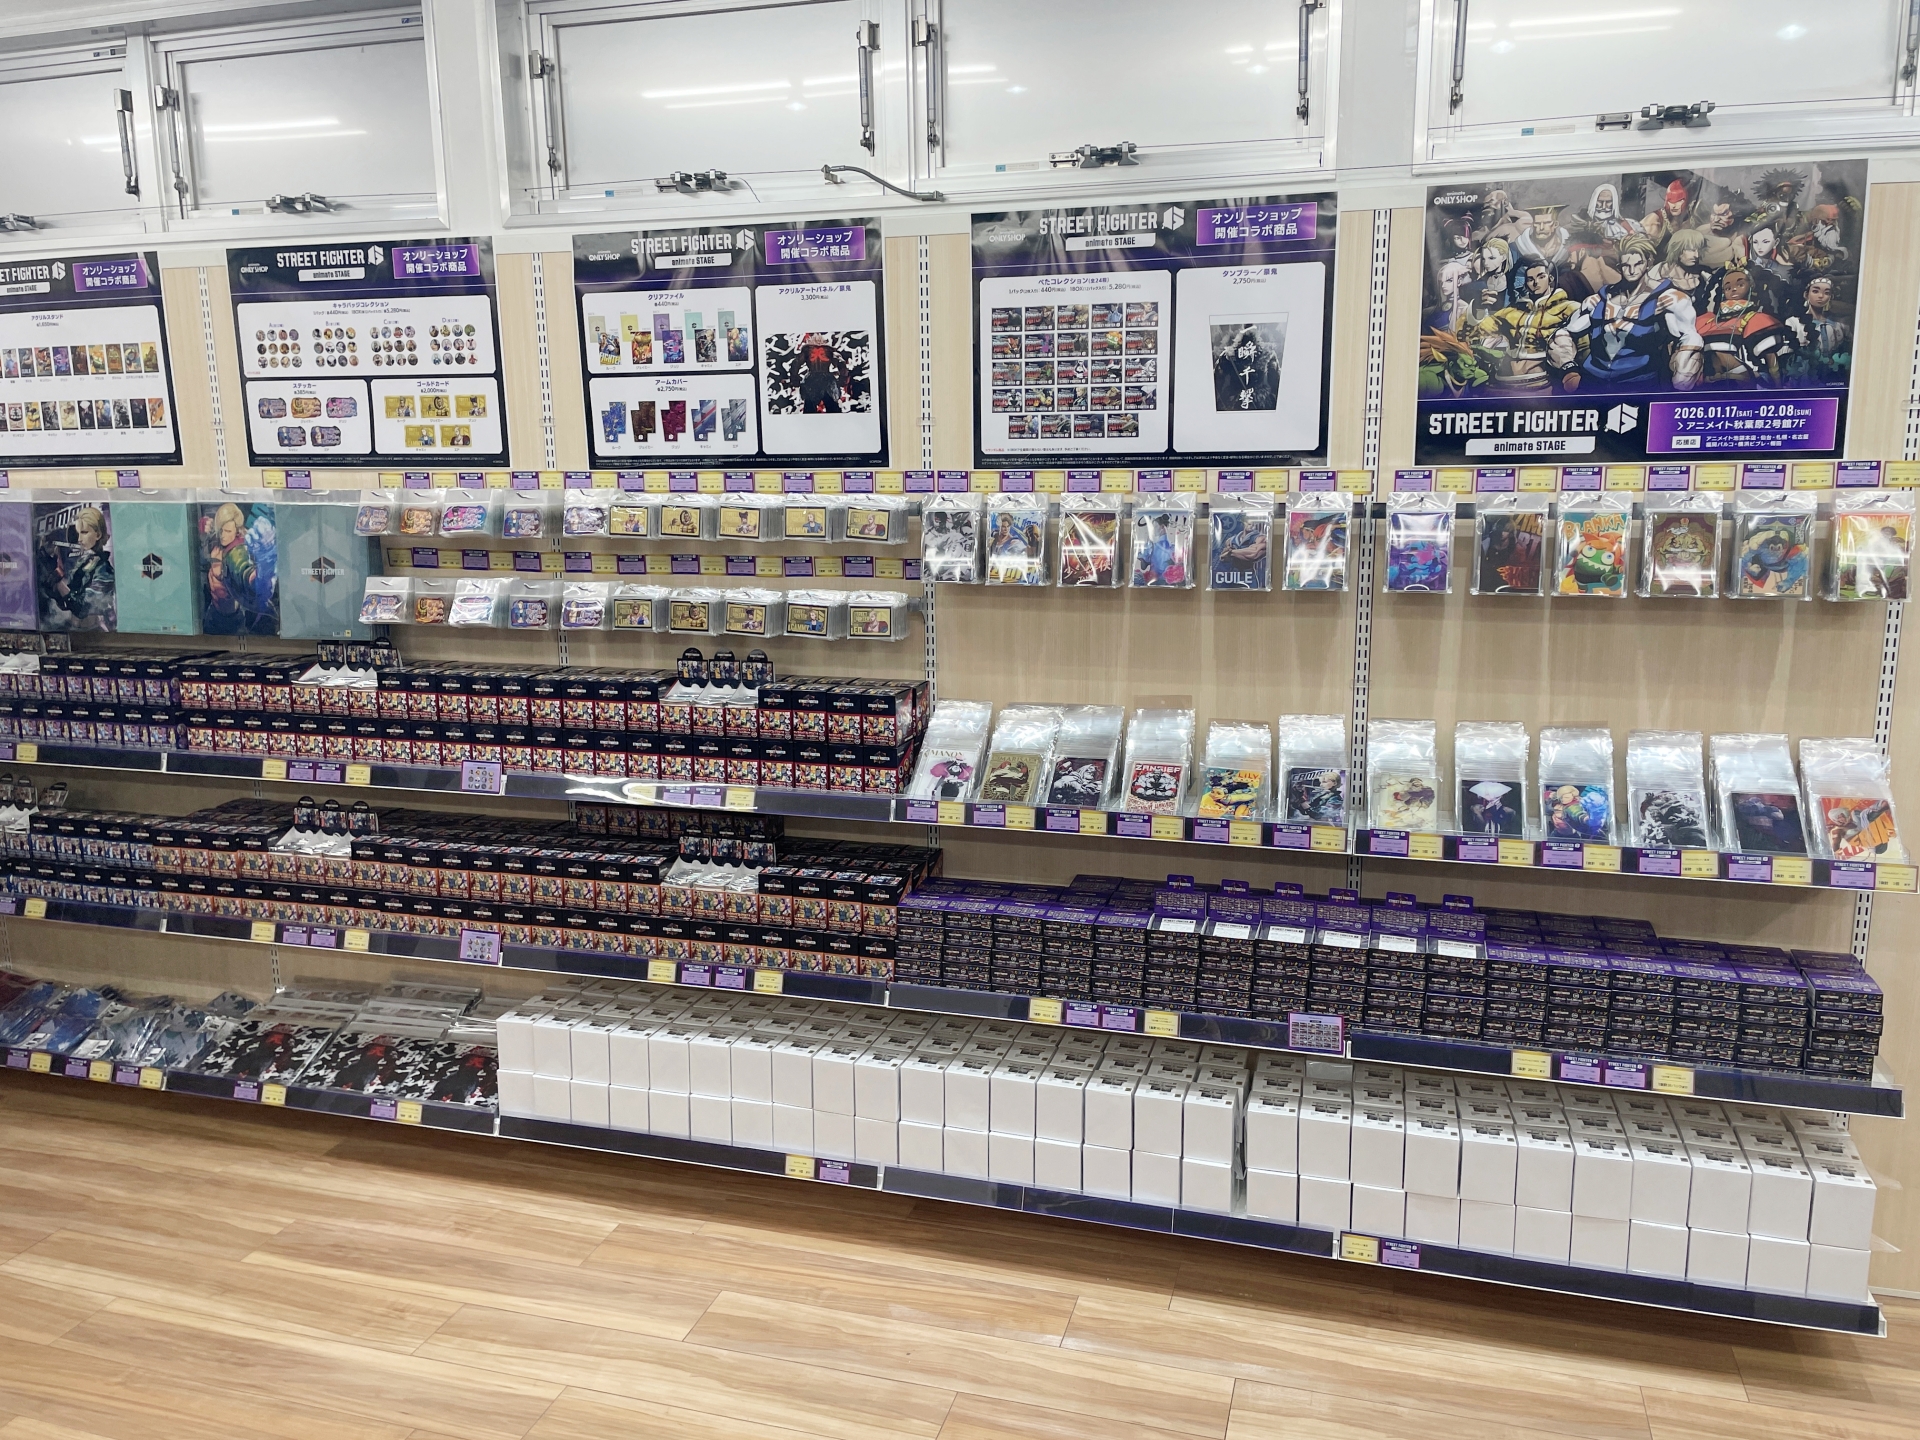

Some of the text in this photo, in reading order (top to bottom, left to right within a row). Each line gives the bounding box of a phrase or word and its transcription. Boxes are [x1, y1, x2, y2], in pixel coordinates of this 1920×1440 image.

[1211, 207, 1303, 223] オンリーショップ
[1039, 214, 1093, 234] STREET
[1098, 211, 1158, 232] FIGHTER
[1214, 222, 1298, 239] 開催コラボ商品
[631, 236, 677, 254] STREET
[681, 233, 732, 252] FIGHTER
[777, 231, 853, 246] オンリーショップ
[1114, 236, 1136, 247] STAGE
[276, 251, 317, 268] STREET
[320, 248, 365, 266] FIGHTER
[402, 249, 468, 260] オンリーショップ
[780, 245, 851, 260] 開催コラボ商品
[696, 256, 715, 265] STAGE
[12, 265, 50, 282] FIGHTER
[82, 263, 137, 275] オンリーショップ
[405, 261, 467, 274] 開催コラボ商品
[85, 274, 138, 287] 開催コラボ商品
[648, 292, 685, 301] クリアファイル
[416, 380, 450, 388] ゴールドカード
[1429, 412, 1508, 435] STREET
[1513, 409, 1599, 433] FIGHTER
[1686, 418, 1807, 431] アニメイト秋葉原2号館7F
[1494, 440, 1566, 452] animate STAGE
[1563, 513, 1625, 541] BLANKA
[1215, 571, 1253, 585] GUILE
[1238, 771, 1259, 780] LILY
